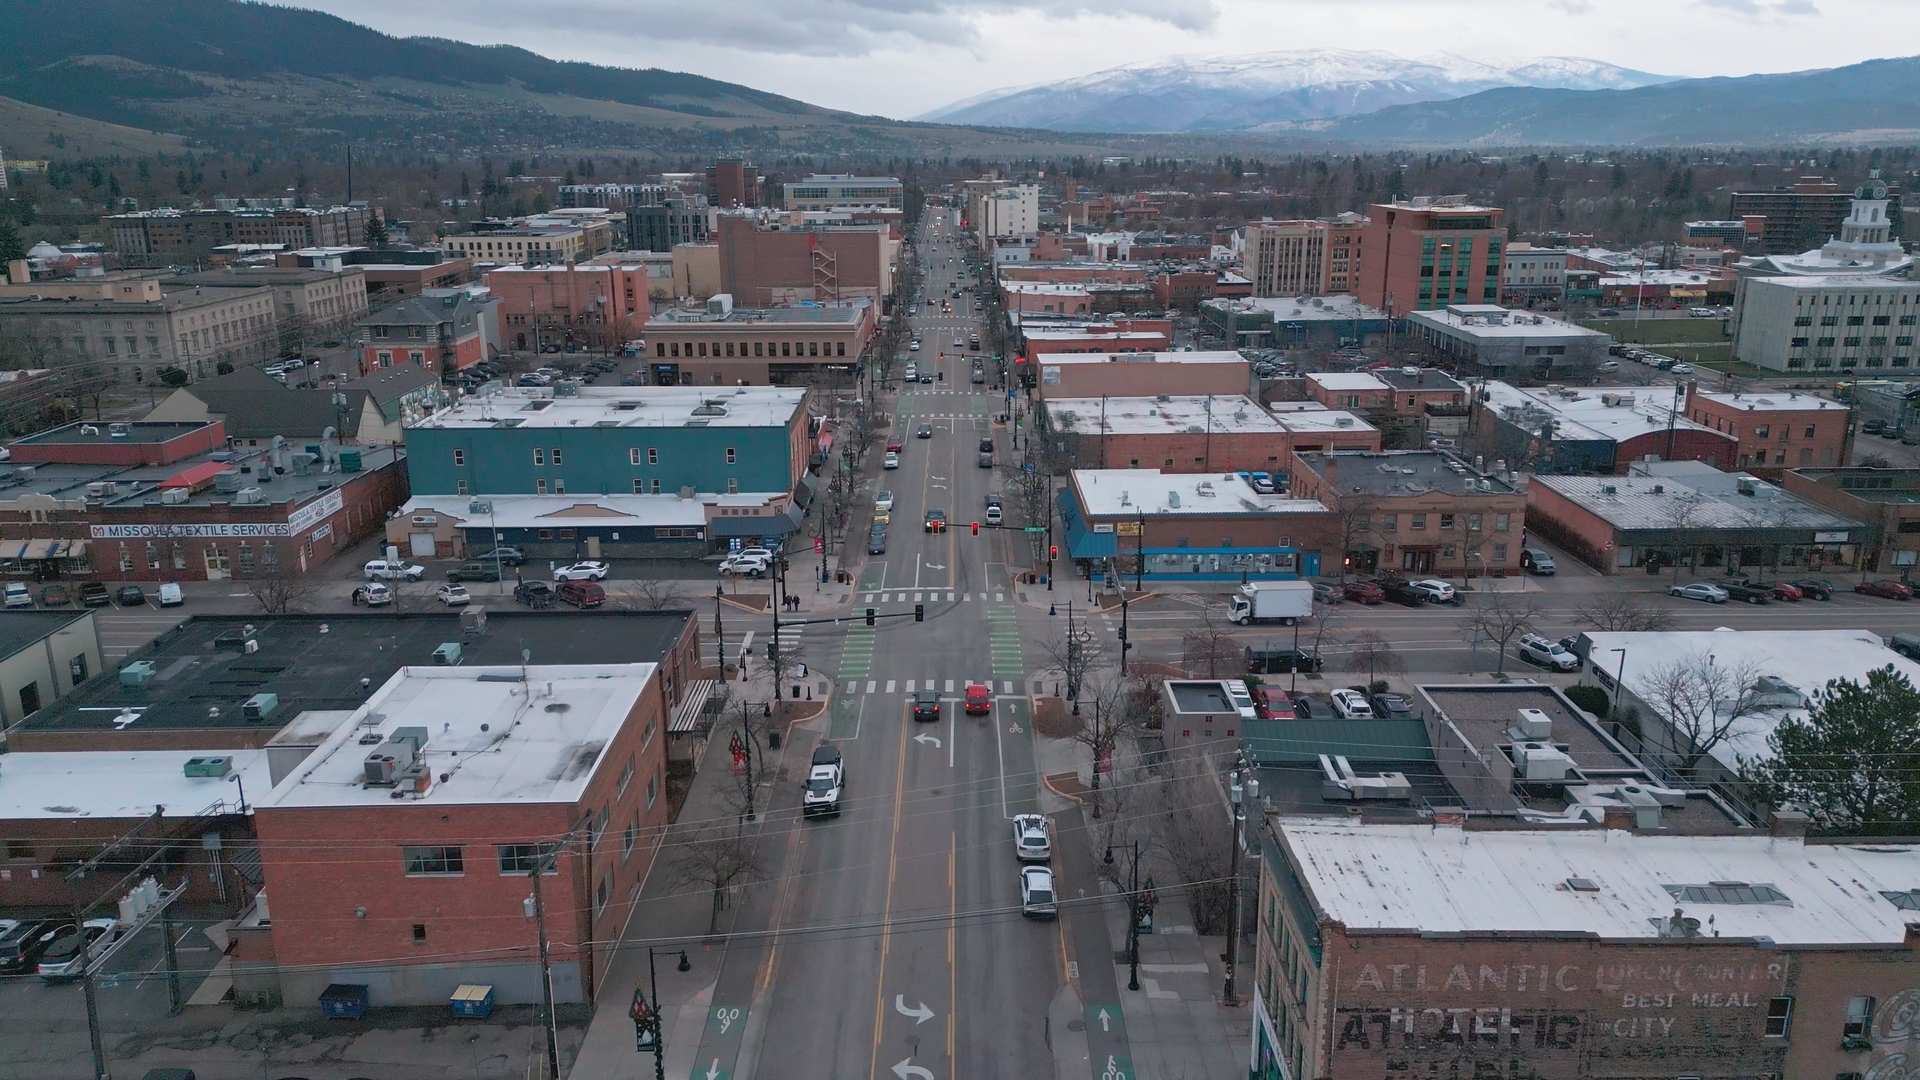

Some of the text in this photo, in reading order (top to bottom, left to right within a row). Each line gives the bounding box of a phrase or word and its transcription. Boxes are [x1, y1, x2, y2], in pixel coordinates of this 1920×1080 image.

[108, 524, 289, 537] MISSOULA TEXTILE SERVICES
[1351, 963, 1581, 992] ATLANTIC
[1621, 991, 1758, 1008] BEST MEAL
[1613, 1016, 1677, 1037] CITY
